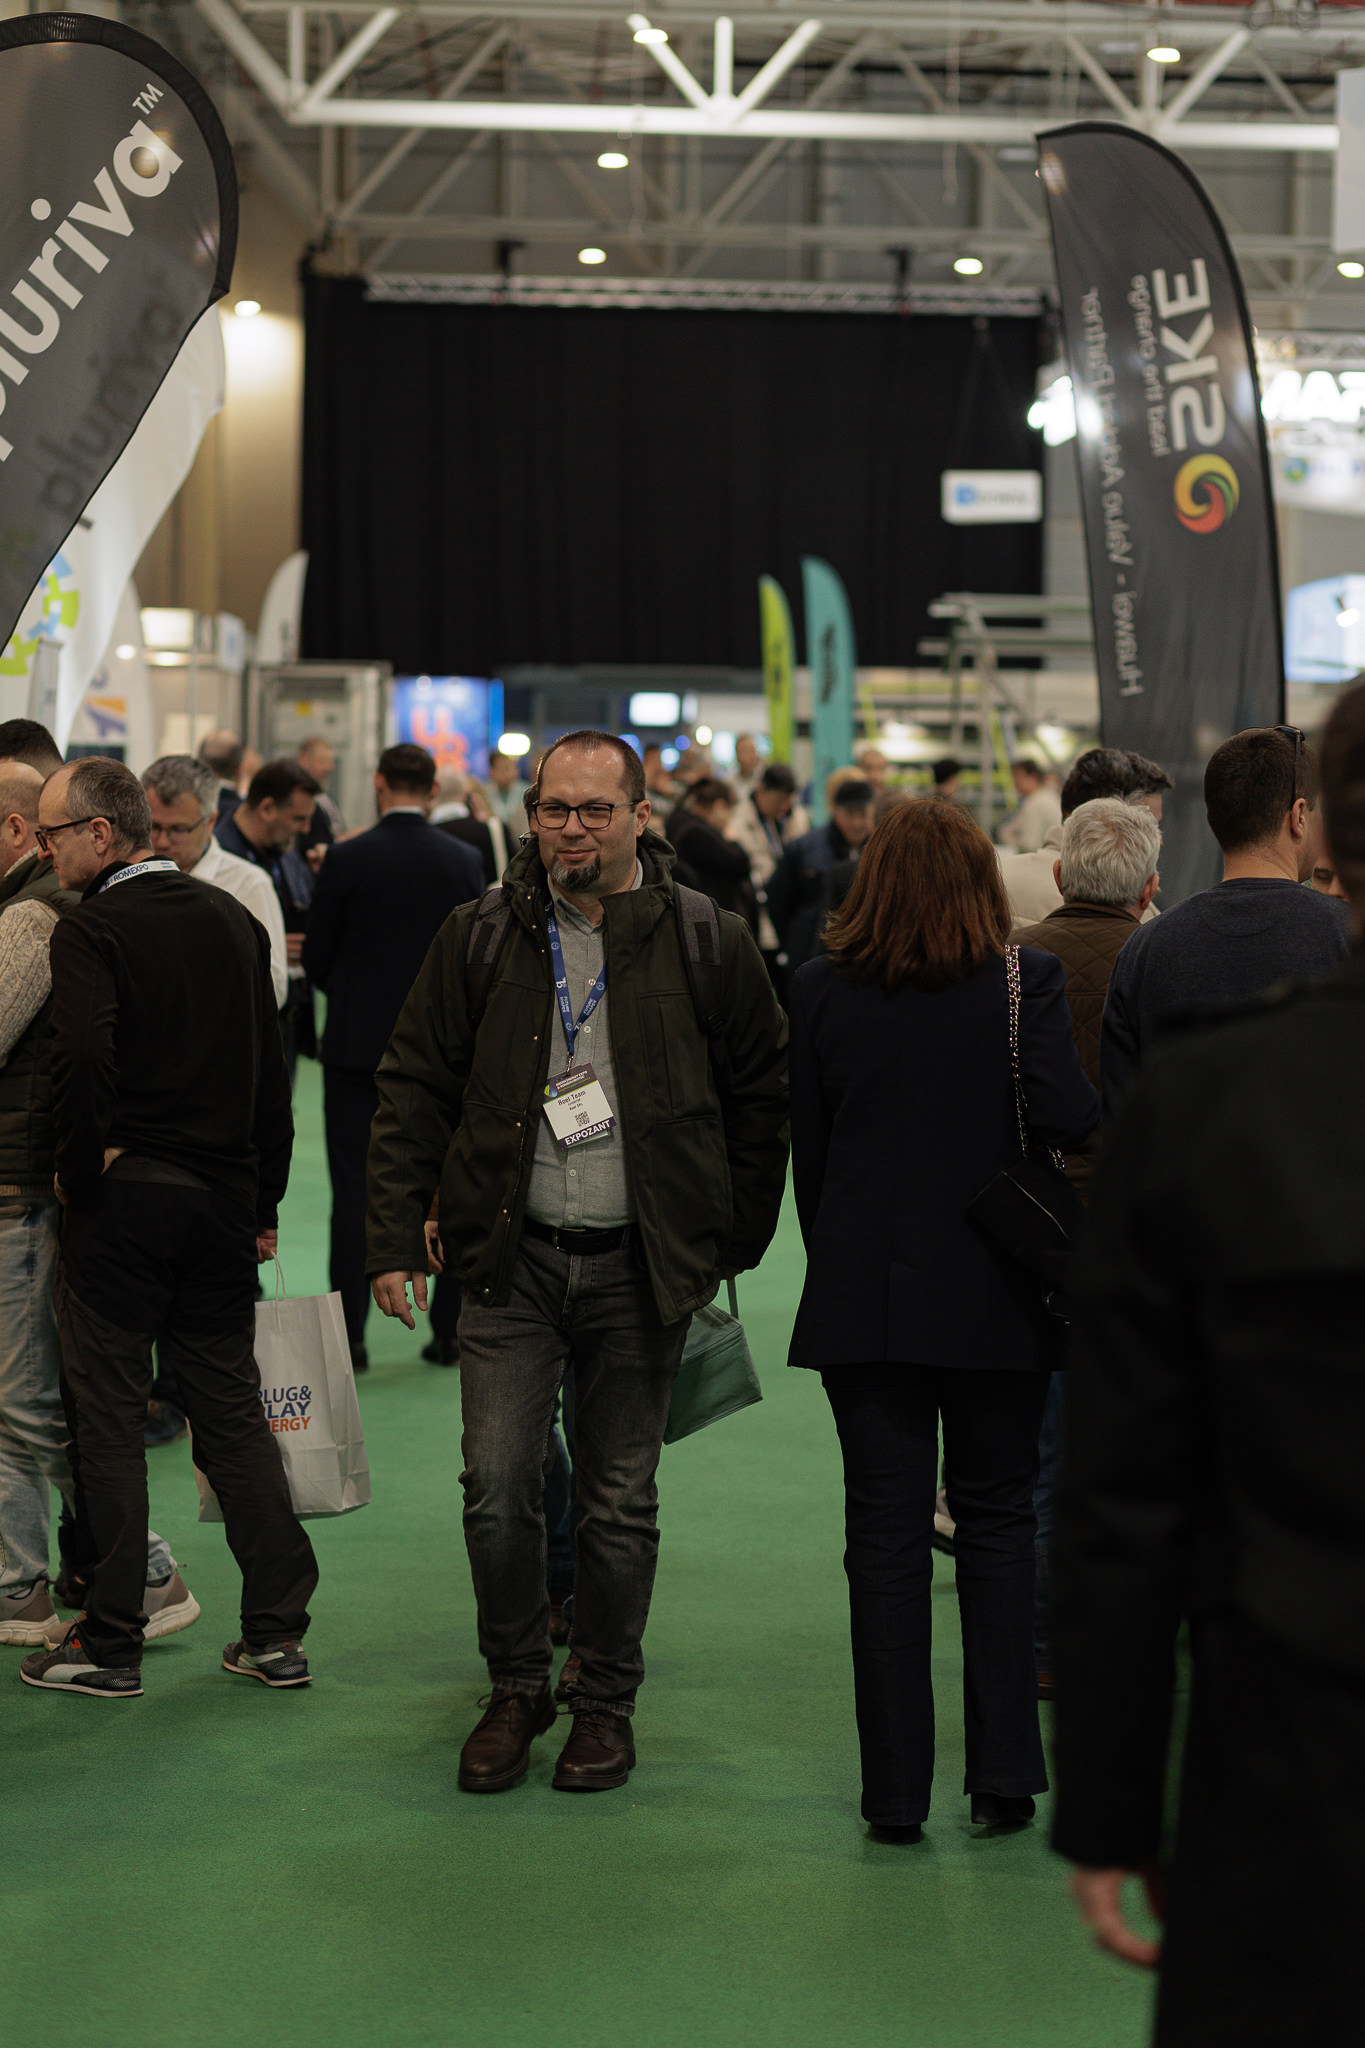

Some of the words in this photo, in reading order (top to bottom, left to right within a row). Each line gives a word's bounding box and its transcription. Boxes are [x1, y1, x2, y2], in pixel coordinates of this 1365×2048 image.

[0, 120, 183, 462] uriva
[113, 864, 149, 881] ROMEXPO
[564, 1119, 611, 1146] EXPOZANT
[268, 1401, 311, 1419] LAY
[268, 1416, 311, 1433] ERGY
